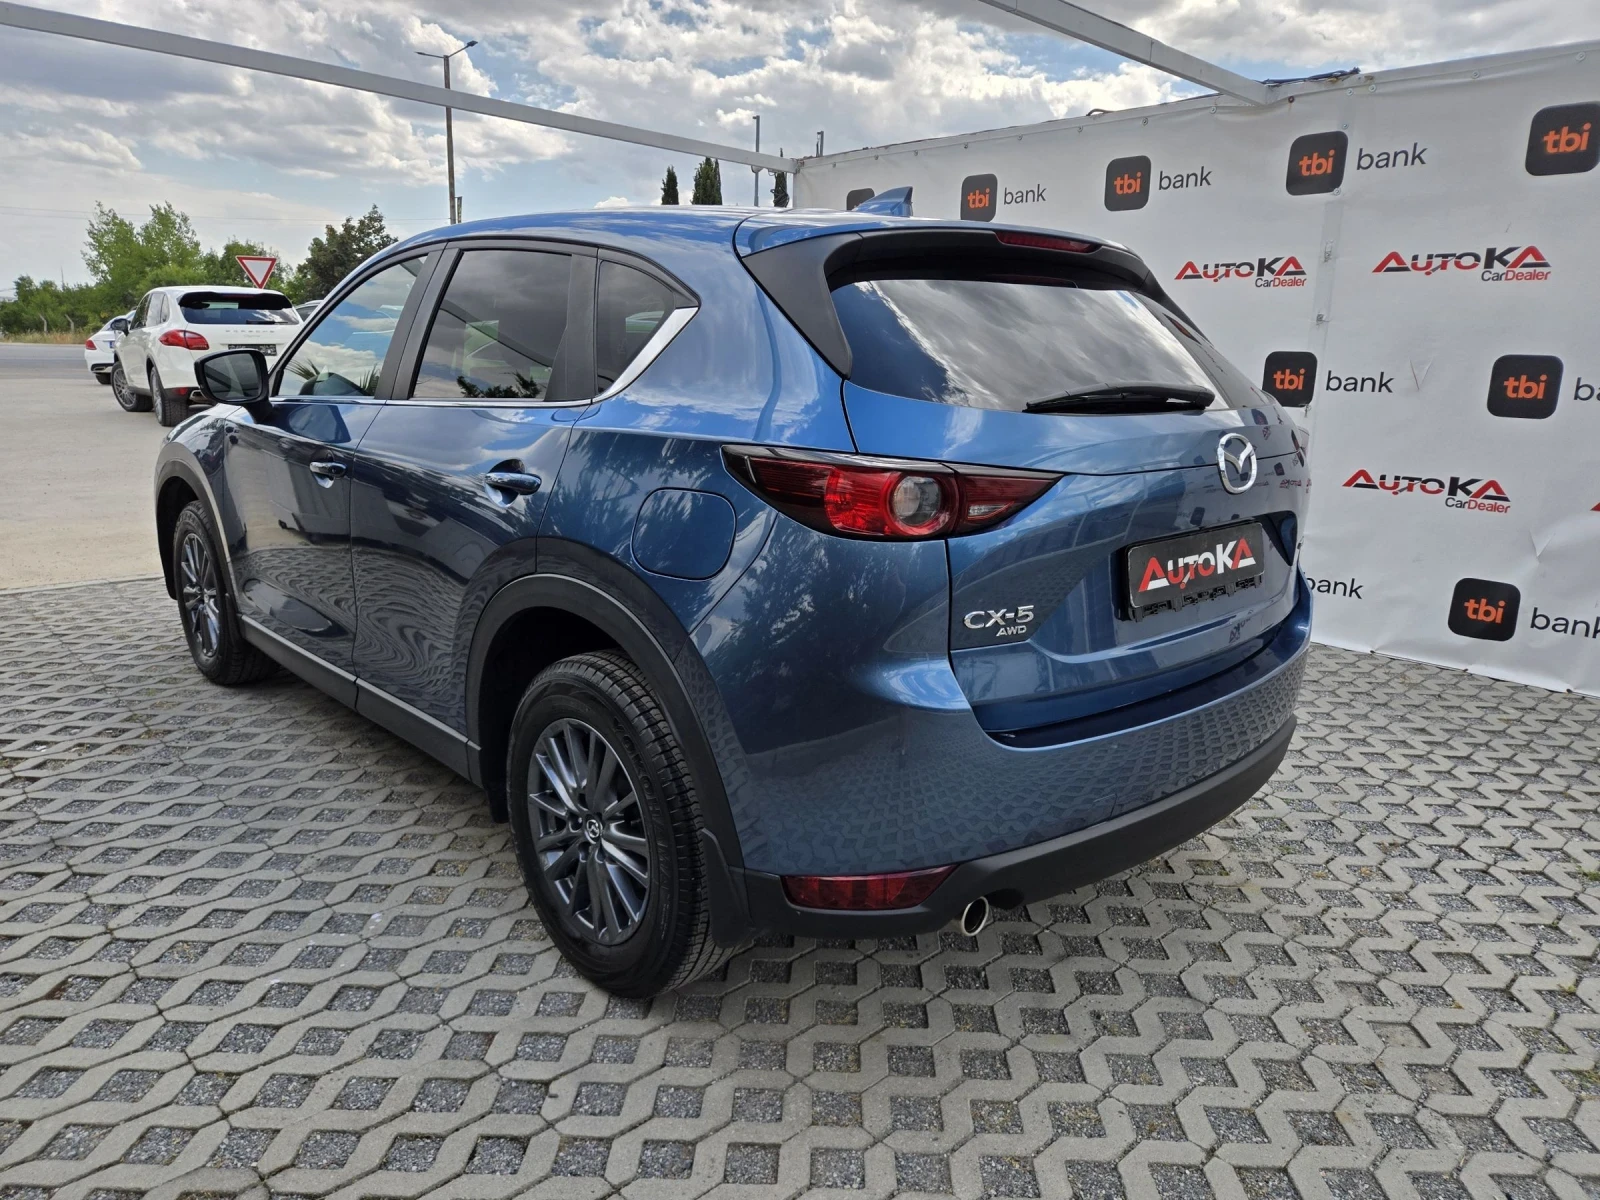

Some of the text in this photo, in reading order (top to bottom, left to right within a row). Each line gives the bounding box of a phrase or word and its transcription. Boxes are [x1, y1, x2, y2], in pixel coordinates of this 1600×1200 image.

[1544, 123, 1591, 154] tbi
[1299, 142, 1427, 176] tbi bank
[1114, 166, 1212, 195] tbi bank
[967, 183, 1046, 209] tbi bank
[1255, 276, 1307, 288] CarDealer
[1481, 269, 1552, 282] CarDealer
[1273, 369, 1395, 393] tbi bank
[1503, 375, 1547, 400] tbi
[1445, 497, 1511, 514] CarDealer
[964, 605, 1034, 629] CX-5
[1464, 598, 1506, 624] tbi
[996, 625, 1027, 637] AWD
[613, 717, 671, 890] YOKOHAMA
